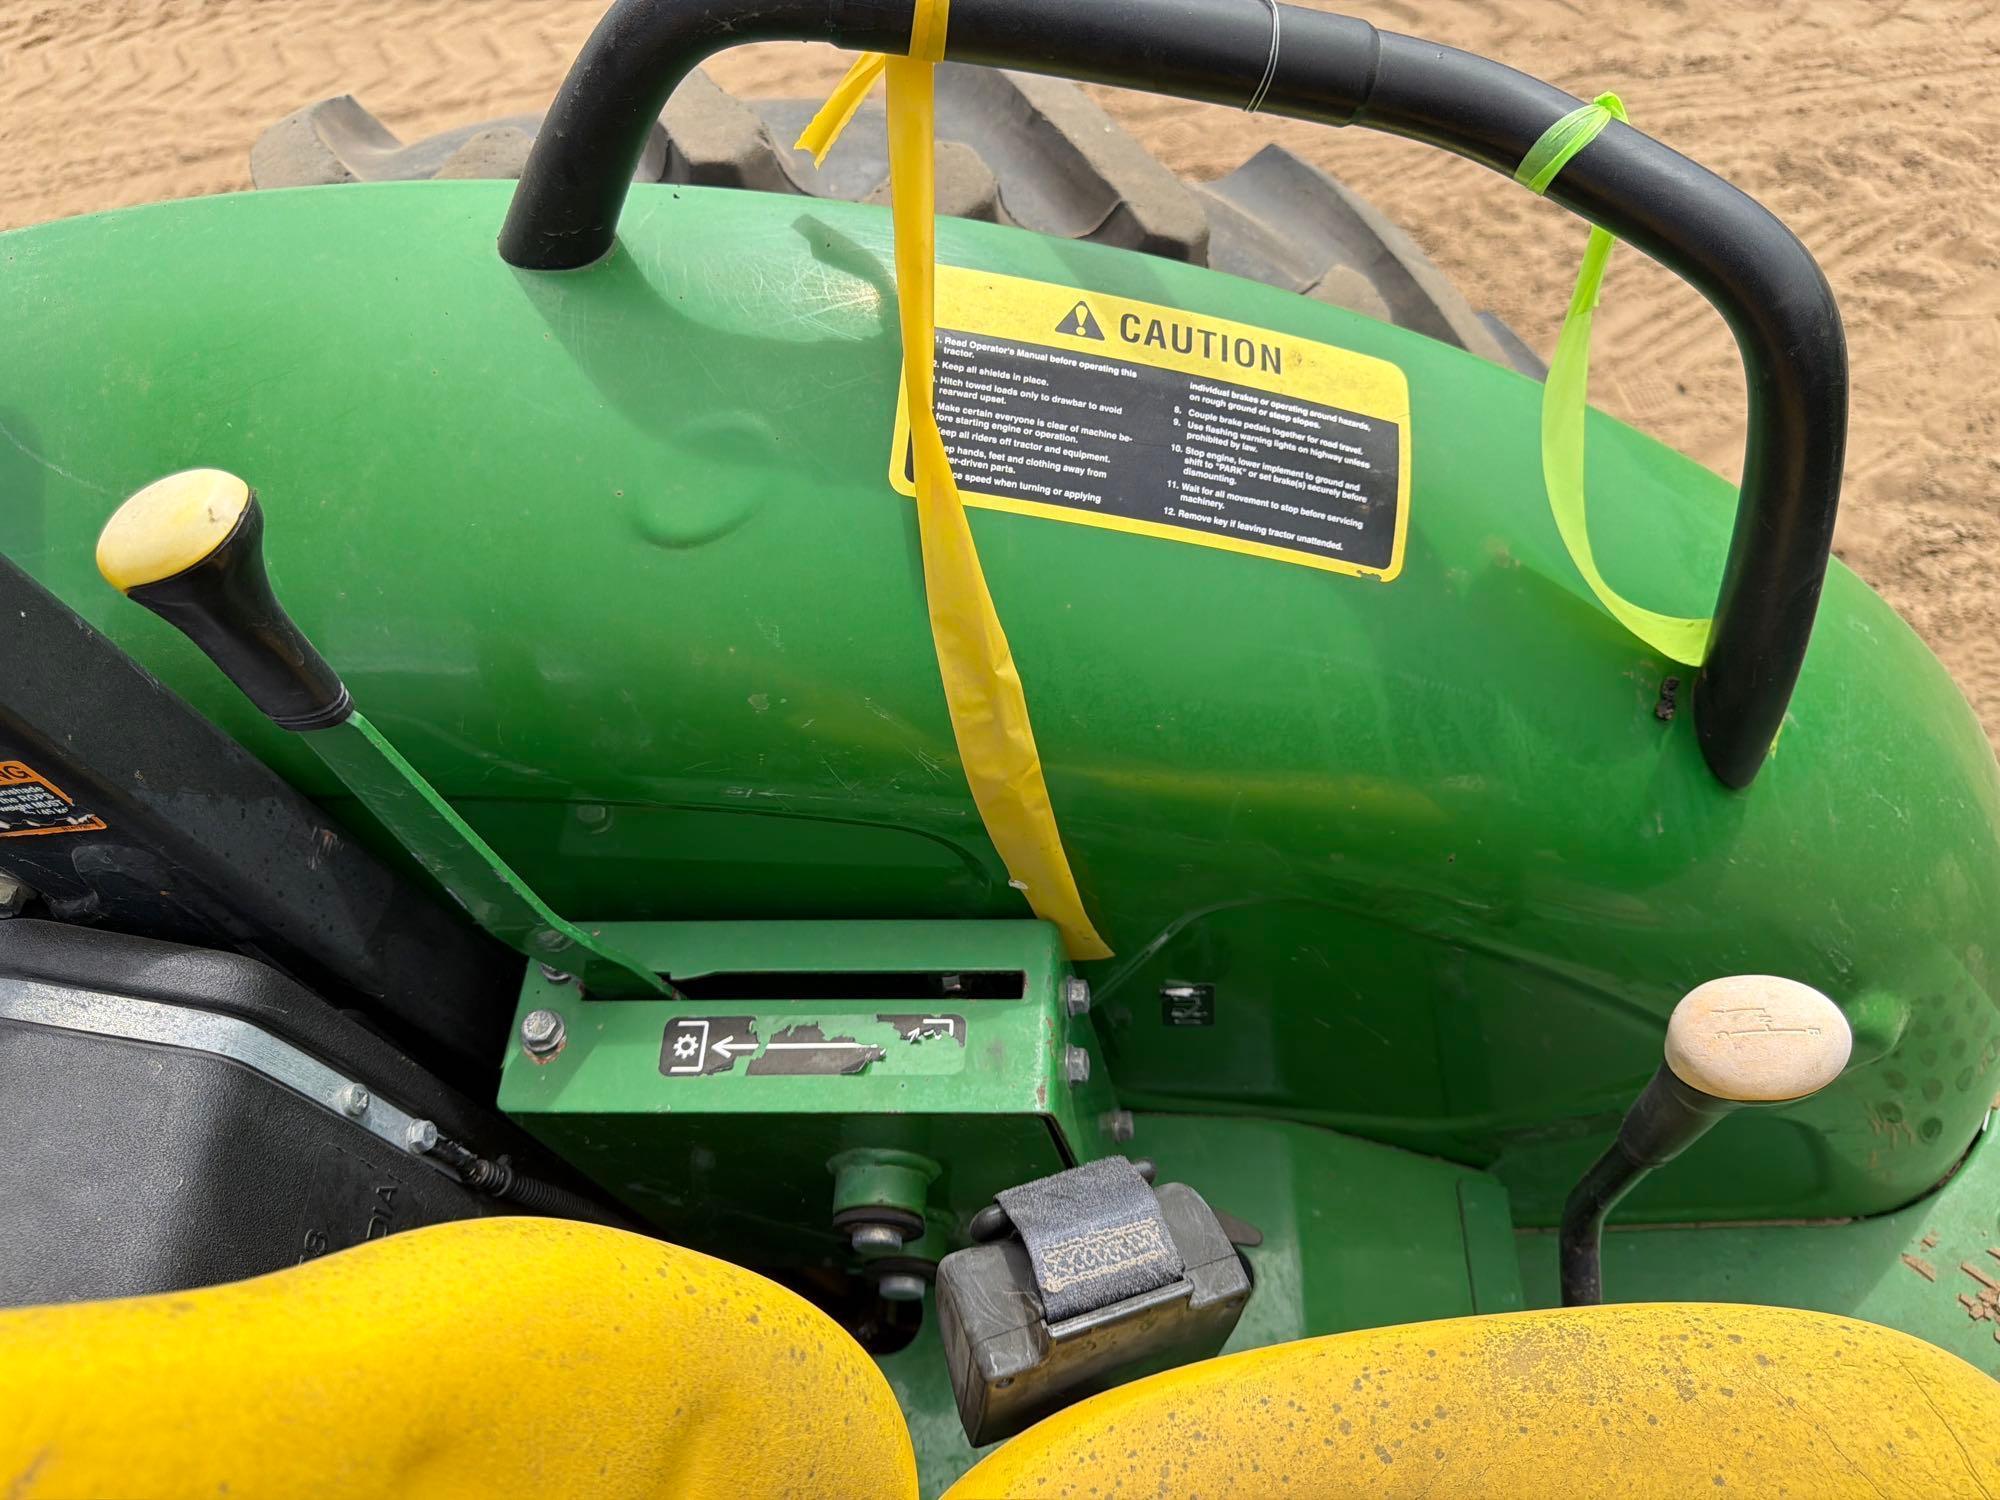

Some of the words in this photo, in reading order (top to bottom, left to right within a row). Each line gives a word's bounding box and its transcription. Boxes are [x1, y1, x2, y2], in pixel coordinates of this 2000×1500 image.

[936, 336, 943, 344] 1.
[944, 337, 968, 348] Read
[969, 341, 1015, 355] Operator's
[1017, 349, 1048, 361] Manual
[1050, 355, 1077, 366] before
[1079, 362, 1119, 376] operating
[1121, 368, 1137, 378] this
[944, 346, 974, 358] tractor.
[1120, 313, 1281, 375] CAUTION
[942, 361, 964, 372] Keep
[979, 368, 1010, 379] shields
[1013, 373, 1021, 381] in
[1023, 376, 1048, 386] place.
[939, 388, 978, 399] rearward
[980, 395, 1006, 404] upset.
[940, 376, 963, 386] Hitch
[966, 381, 992, 391] towed
[994, 385, 1017, 396] loads
[1020, 391, 1039, 401] only
[1052, 396, 1087, 407] drawbar
[1099, 405, 1122, 414] avoid
[1190, 382, 1229, 397] individual
[1231, 391, 1259, 403] brakes
[1270, 401, 1308, 416] operating
[1309, 411, 1337, 422] around
[1338, 417, 1371, 431] hazards,
[936, 413, 953, 422] fore
[955, 417, 989, 430] starting
[992, 423, 1021, 433] engine
[1035, 431, 1078, 443] operation.
[937, 402, 960, 413] Make
[963, 408, 993, 418] certain
[995, 413, 1035, 425] everyone
[1037, 418, 1044, 426] is
[1047, 421, 1068, 430] clear
[1081, 428, 1117, 439] machine
[1119, 433, 1132, 442] be-
[1202, 397, 1226, 407] rough
[1228, 403, 1257, 414] ground
[1269, 412, 1291, 422] steep
[1293, 417, 1321, 429] slopes.
[1173, 418, 1180, 426] 9.
[1188, 421, 1203, 431] Use
[1206, 425, 1238, 441] flashing
[1240, 434, 1272, 447] warning
[1274, 440, 1296, 451] lights
[1310, 448, 1343, 463] highway
[1344, 458, 1370, 468] unless
[1174, 406, 1181, 414] 8.
[1189, 409, 1217, 421] Couple
[1219, 416, 1242, 426] brake
[1244, 422, 1270, 433] pedals
[1272, 428, 1305, 440] together
[1307, 435, 1319, 443] for
[1320, 440, 1338, 449] road
[1339, 443, 1363, 455] travel.
[1187, 433, 1228, 446] prohibited
[1230, 440, 1240, 450] by
[1242, 443, 1257, 452] law.
[945, 446, 954, 454] ep
[957, 446, 986, 458] hands,
[989, 451, 1005, 461] feet
[1007, 456, 1024, 464] and
[1026, 458, 1061, 472] clothing
[1063, 465, 1085, 476] away
[1087, 468, 1106, 478] from
[959, 431, 969, 439] all
[972, 433, 997, 443] riders
[1014, 440, 1042, 451] tractor
[1045, 446, 1061, 454] and
[1063, 449, 1110, 463] equipment.
[949, 458, 988, 469] er-driven
[991, 464, 1015, 474] parts.
[1172, 444, 1182, 452] 10.
[1186, 447, 1205, 460] Stop
[1207, 452, 1236, 465] engine,
[1239, 458, 1260, 468] lower
[1262, 463, 1304, 478] implement
[1315, 476, 1344, 487] ground
[1345, 483, 1360, 491] and
[1183, 468, 1236, 485] dismounting.
[1185, 458, 1203, 467] shift
[1205, 461, 1213, 469] to
[1259, 473, 1271, 481] set
[1273, 475, 1306, 490] brake(s)
[1308, 484, 1340, 498] securely
[1342, 491, 1367, 503] before
[965, 475, 992, 484] speed
[994, 478, 1017, 488] when
[1020, 482, 1051, 495] turning
[1064, 491, 1101, 504] applying
[1168, 480, 1179, 489] 11.
[1182, 483, 1200, 493] Wait
[1202, 487, 1213, 495] for
[1227, 493, 1269, 507] movement
[1271, 501, 1279, 509] to
[1281, 505, 1299, 514] stop
[1300, 508, 1326, 519] before
[1327, 515, 1363, 529] servicing
[1180, 495, 1224, 510] machinery.
[1164, 507, 1175, 515] 12.
[1178, 510, 1212, 523] Remove
[1214, 517, 1228, 527] key
[1237, 521, 1266, 535] leaving
[1269, 528, 1295, 539] tractor
[1297, 535, 1342, 550] unattended.
[17, 792, 55, 802] ROPS
[31, 799, 65, 809] MUST
